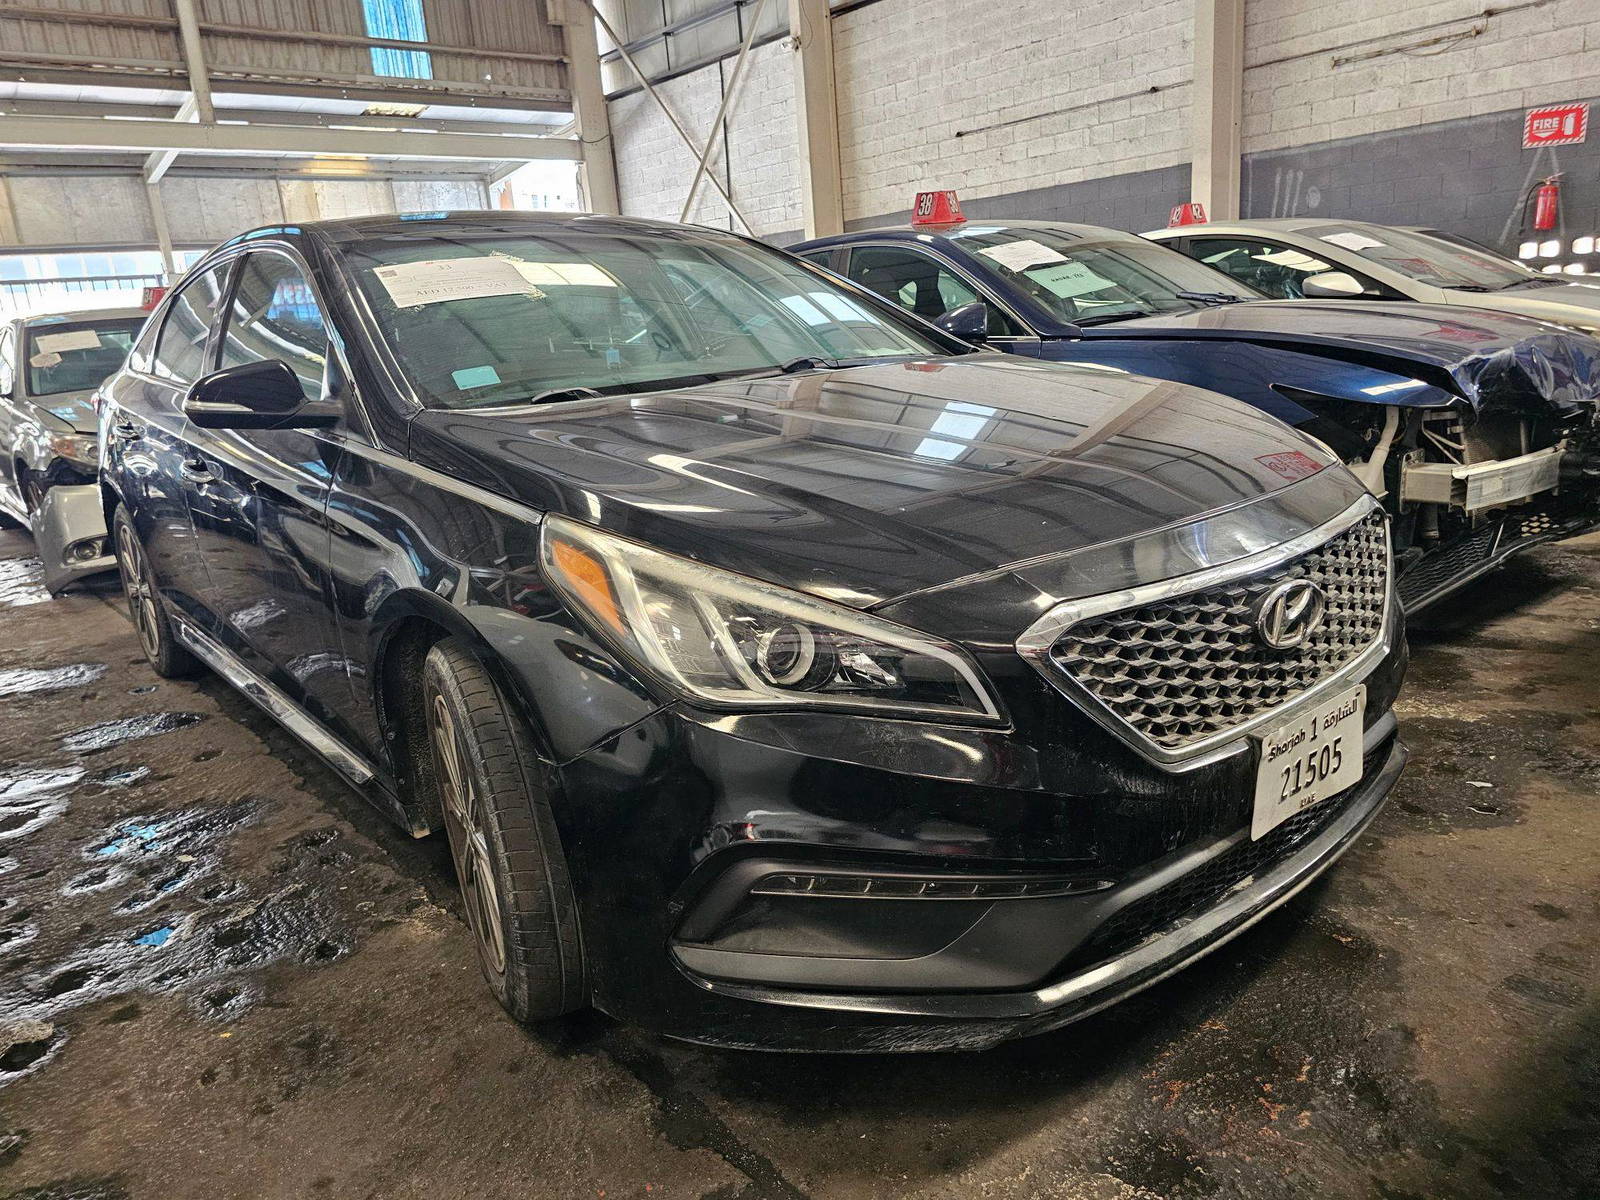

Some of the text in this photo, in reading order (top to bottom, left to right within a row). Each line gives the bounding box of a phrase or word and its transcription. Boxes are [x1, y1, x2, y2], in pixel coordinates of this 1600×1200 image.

[1532, 117, 1560, 131] FIRE
[918, 193, 933, 215] 38
[1191, 203, 1203, 219] 42
[1322, 698, 1359, 731] الشارقة
[1267, 716, 1318, 762] Sharjah 1
[1279, 736, 1342, 802] 21505
